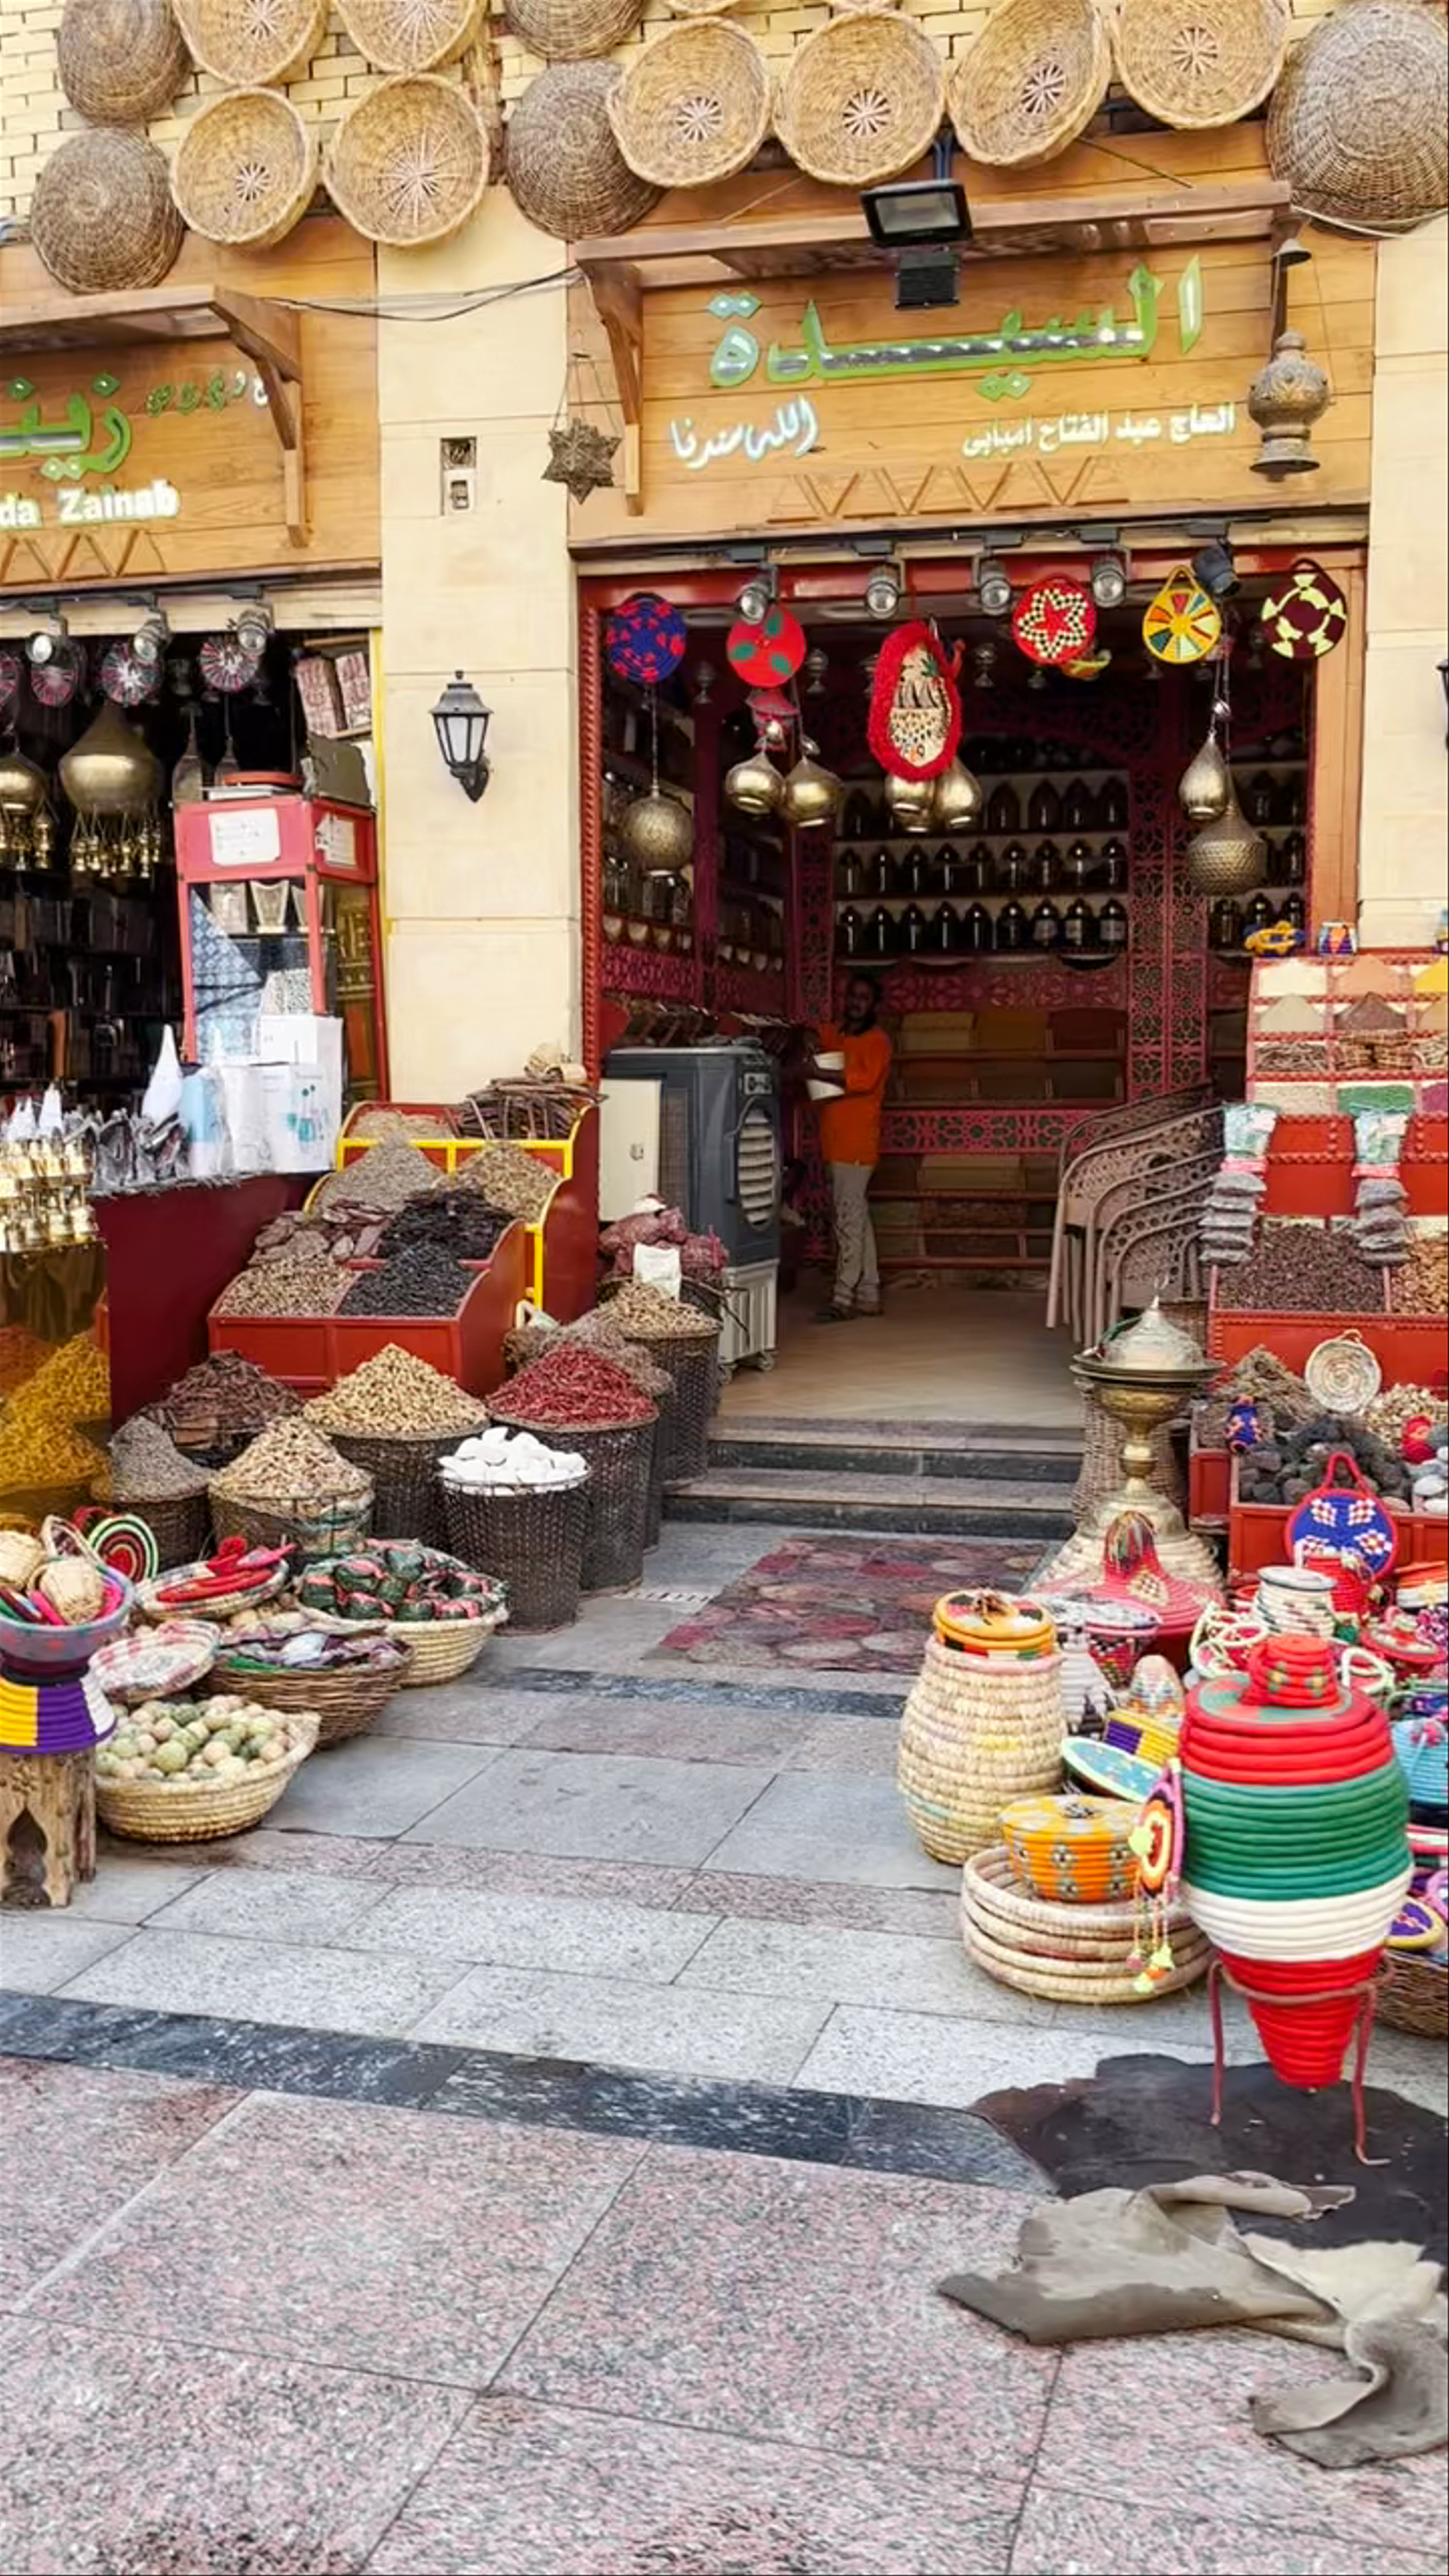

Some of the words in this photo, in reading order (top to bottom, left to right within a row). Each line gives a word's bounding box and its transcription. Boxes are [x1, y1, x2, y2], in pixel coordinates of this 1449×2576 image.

[1038, 410, 1109, 452] الفتاح
[1114, 412, 1162, 445] عبد
[1169, 401, 1235, 443] الحاج
[58, 479, 180, 526] Zainab
